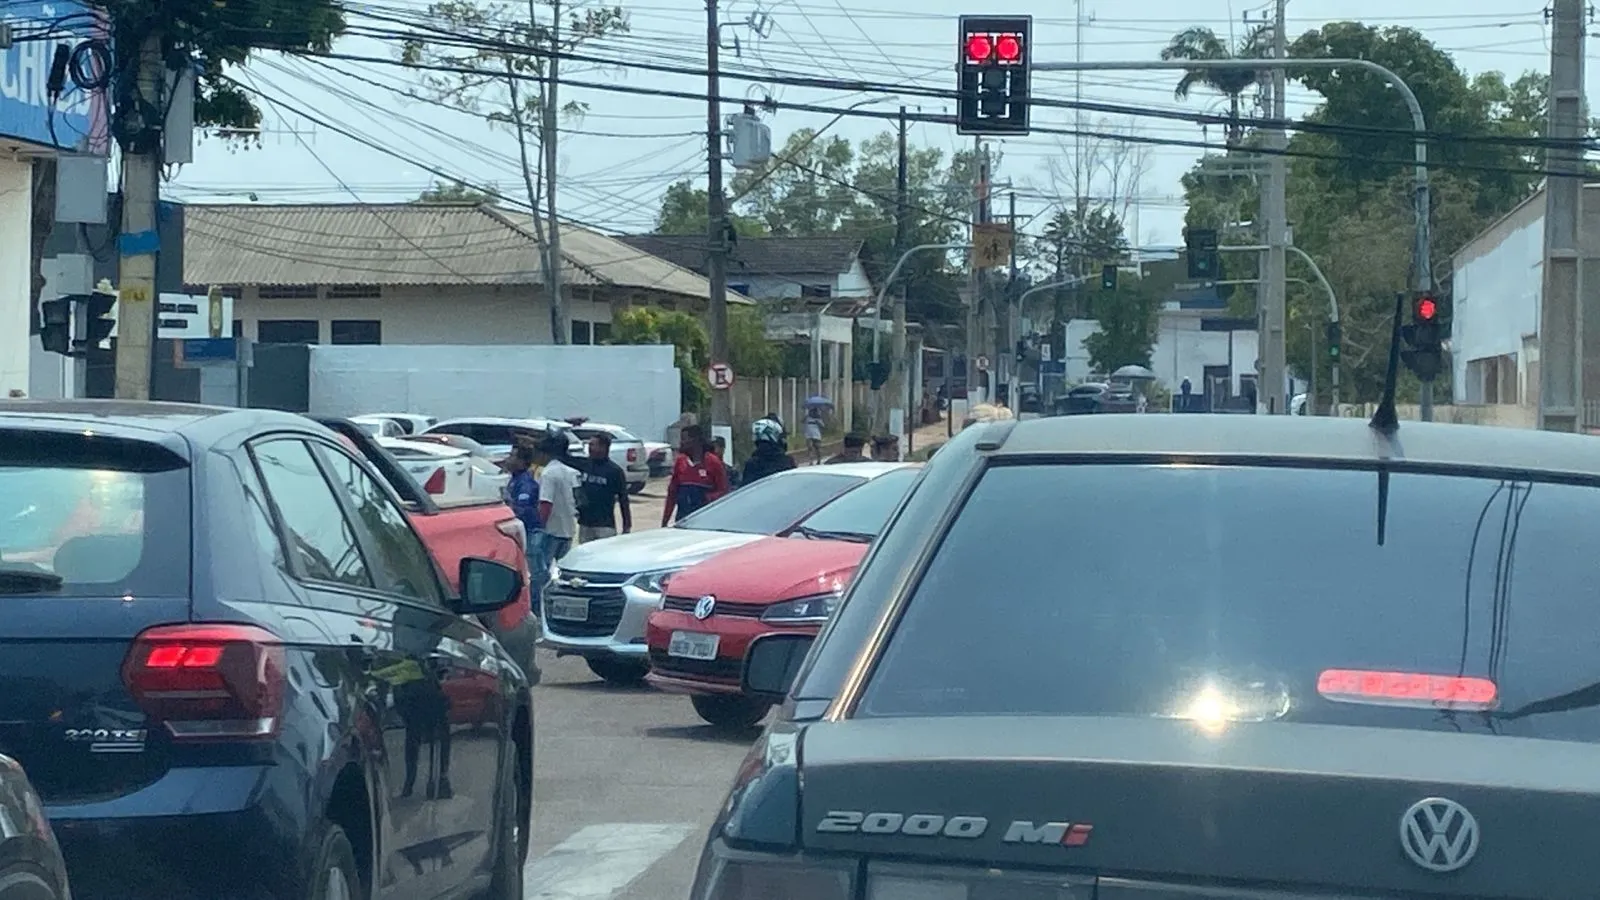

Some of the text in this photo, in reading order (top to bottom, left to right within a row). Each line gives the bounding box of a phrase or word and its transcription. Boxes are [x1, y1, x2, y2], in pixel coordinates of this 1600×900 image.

[816, 811, 1094, 846] 2000 Mi
[1401, 797, 1479, 871] VW
